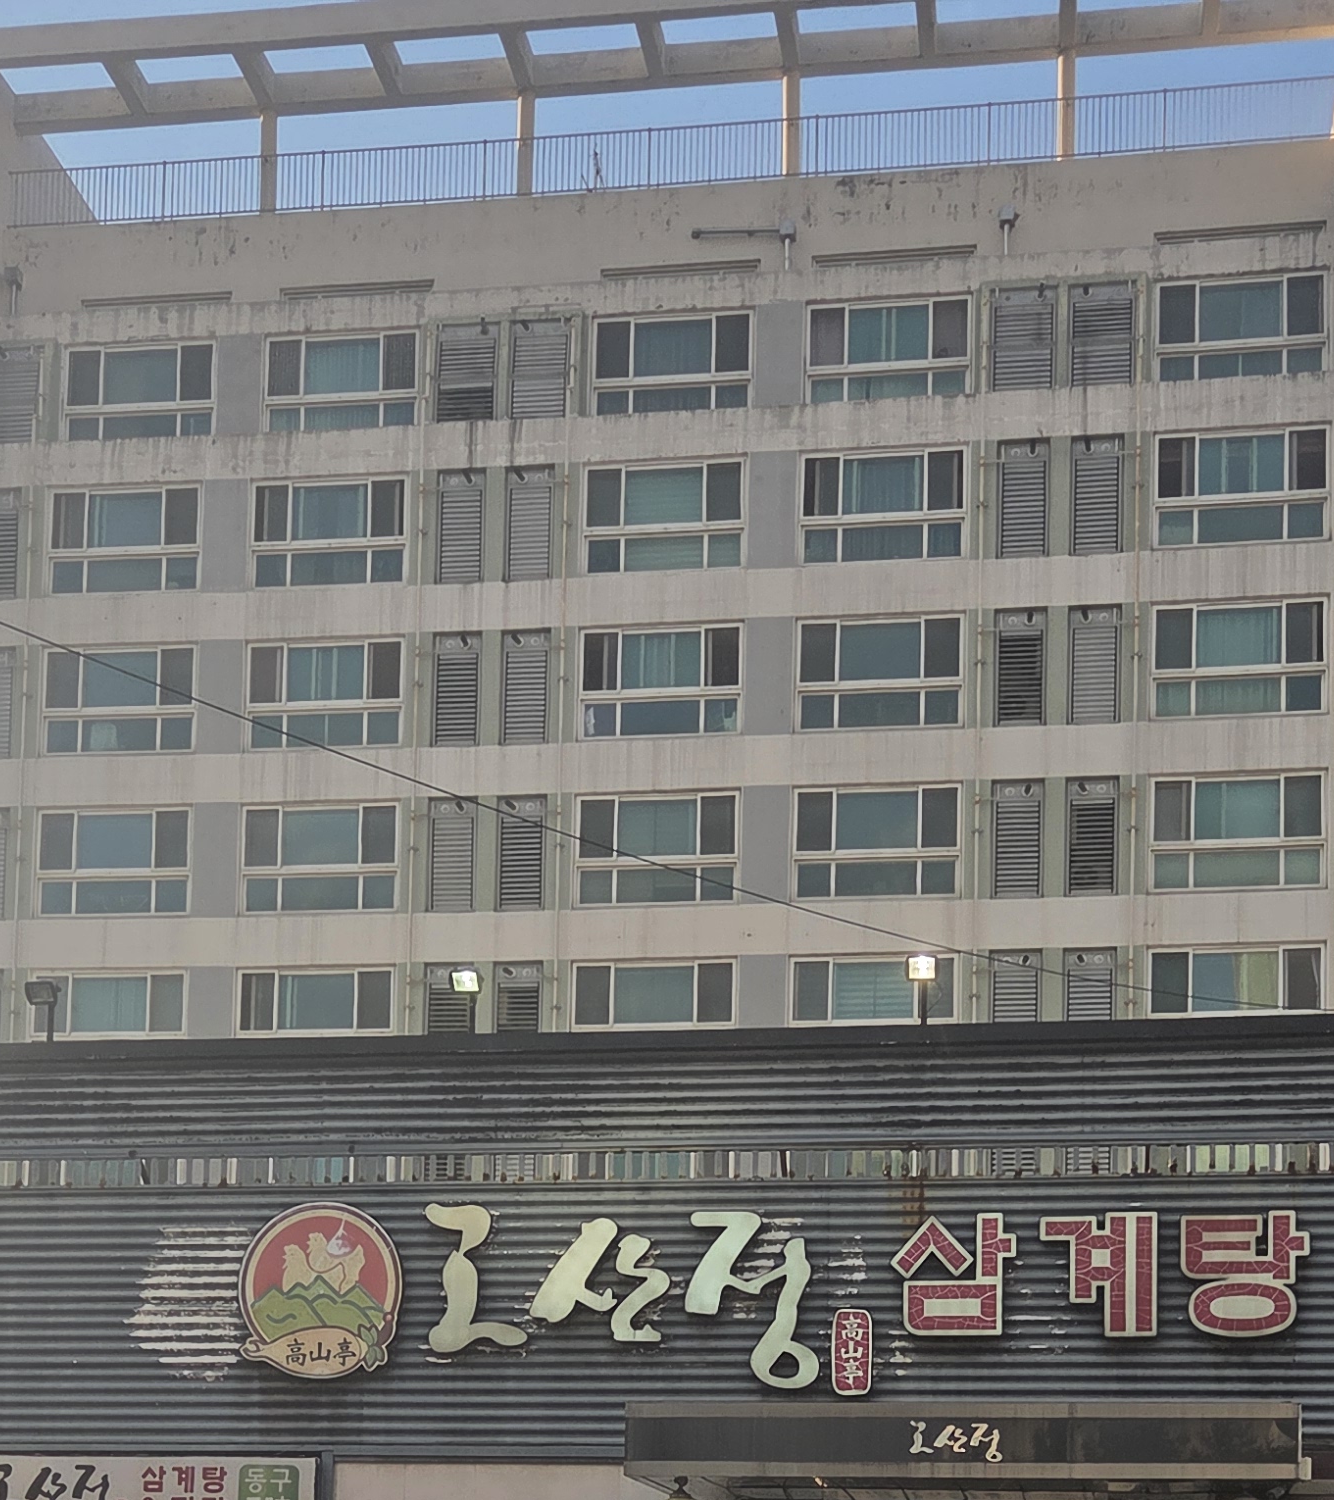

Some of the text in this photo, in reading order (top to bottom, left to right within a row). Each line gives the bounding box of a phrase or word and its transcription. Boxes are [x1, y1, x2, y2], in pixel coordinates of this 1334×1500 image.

[423, 1202, 820, 1389] 고산정
[890, 1209, 1311, 1337] 삼계탕
[285, 1337, 357, 1367] 高山亭
[840, 1314, 865, 1387] 高山亭
[141, 1465, 228, 1494] 삼계탕
[243, 1468, 292, 1495] 동구
